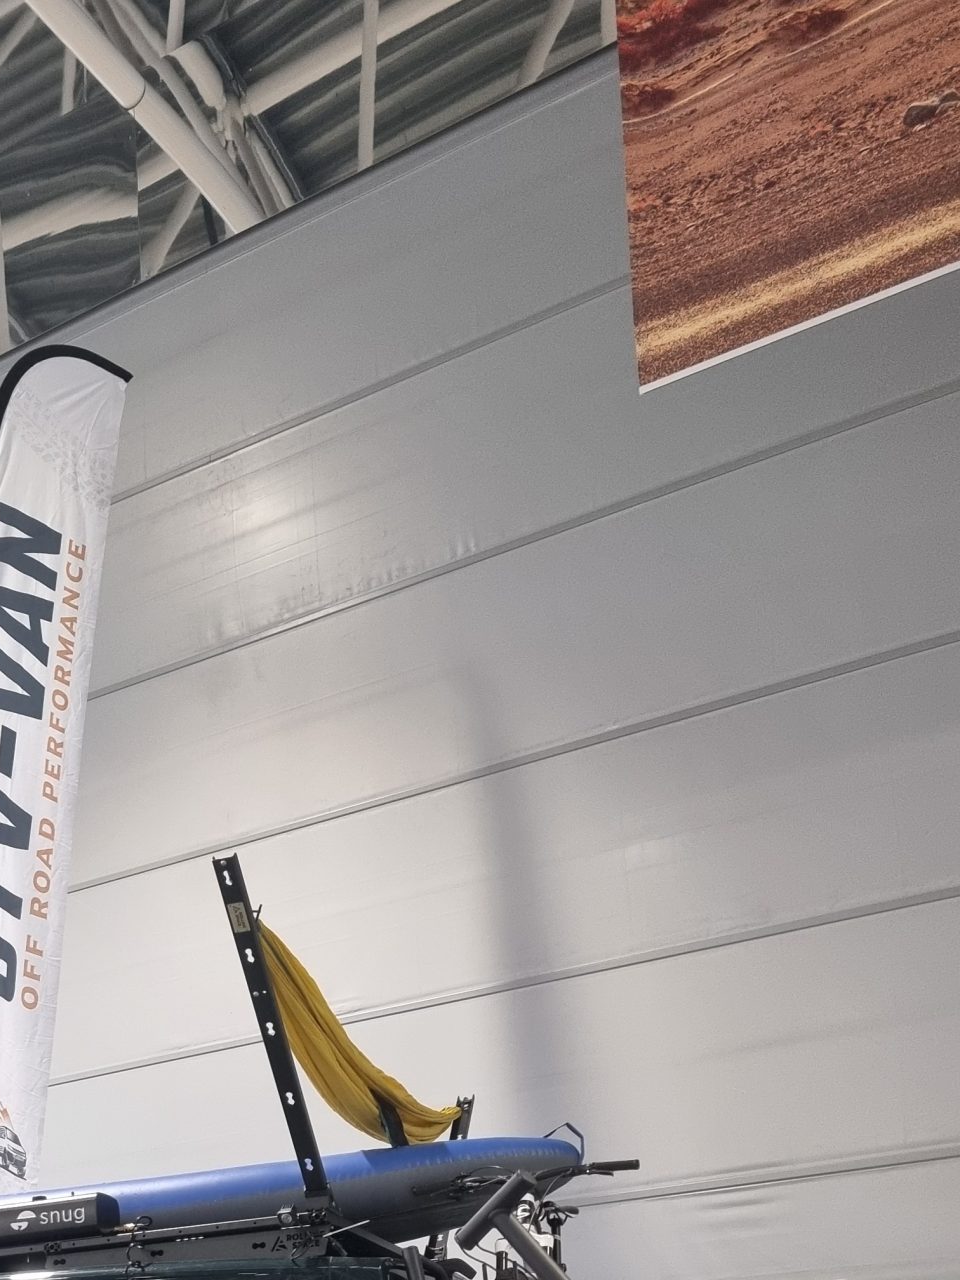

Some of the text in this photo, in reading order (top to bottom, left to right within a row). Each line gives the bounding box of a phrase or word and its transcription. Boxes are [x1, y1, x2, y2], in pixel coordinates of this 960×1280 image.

[20, 539, 87, 1011] OFF ROAD PERFORMANCE
[39, 1207, 85, 1225] snug
